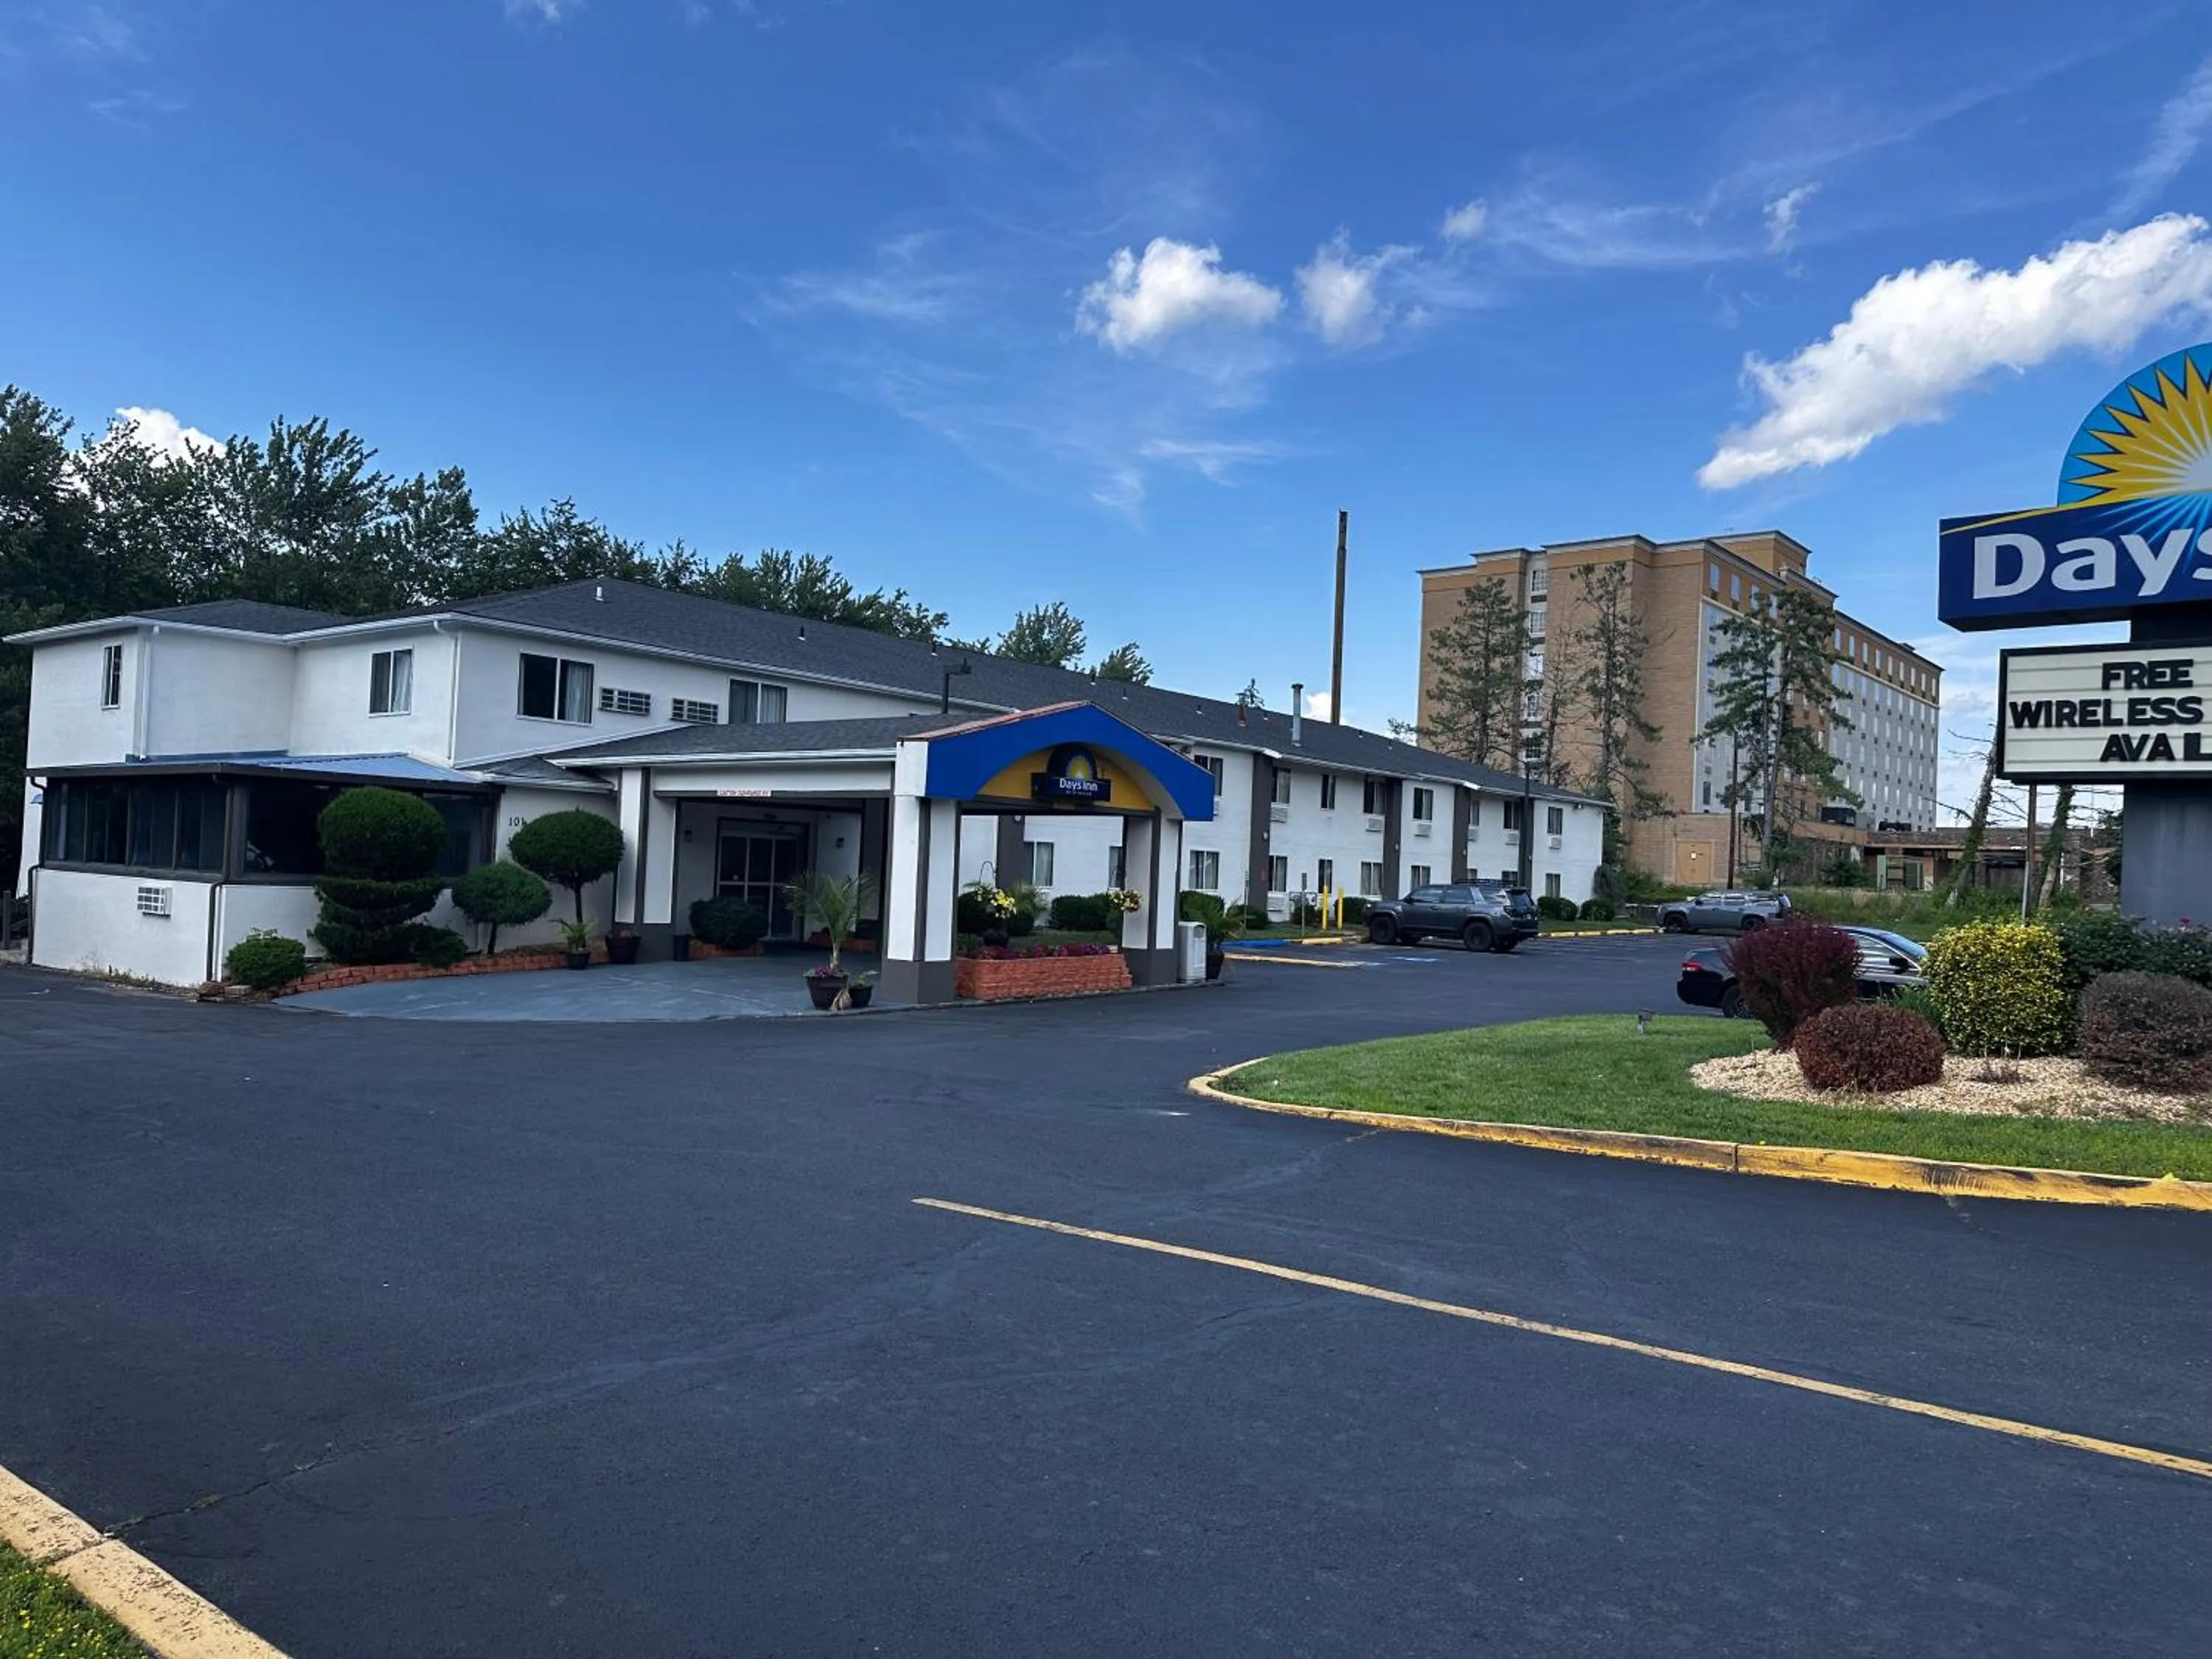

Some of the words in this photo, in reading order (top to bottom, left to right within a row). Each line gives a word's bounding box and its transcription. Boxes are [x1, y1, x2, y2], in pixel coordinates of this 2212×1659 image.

[2102, 658, 2194, 691] FREE
[2009, 696, 2204, 728] WIRELESS
[1060, 778, 1082, 790] Days
[1082, 781, 1098, 791] Inn
